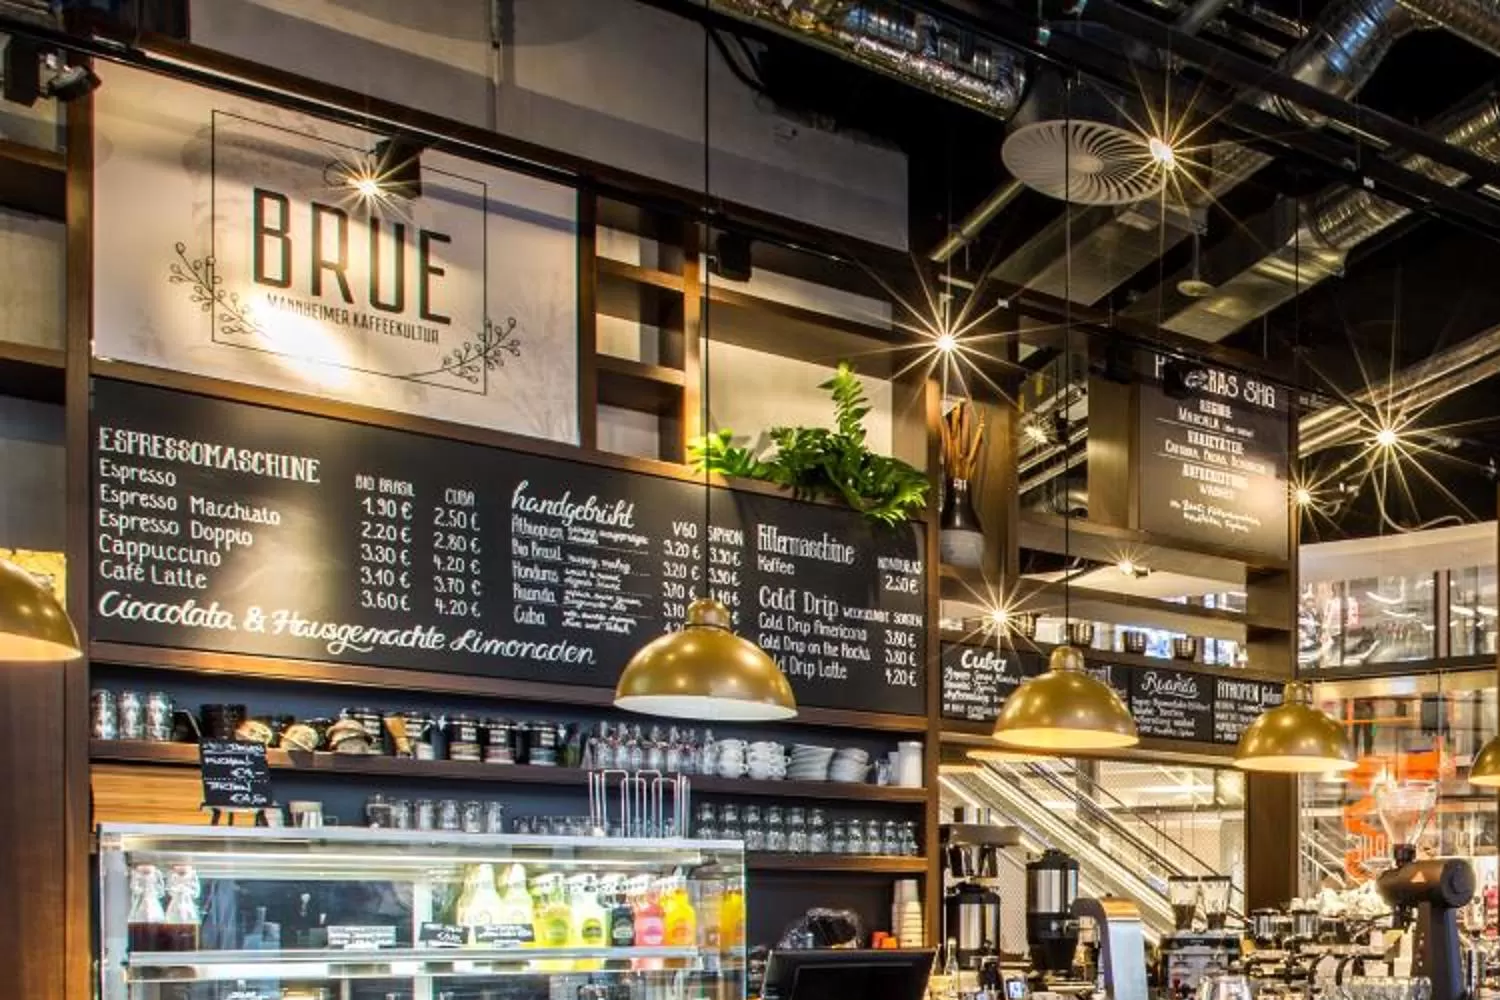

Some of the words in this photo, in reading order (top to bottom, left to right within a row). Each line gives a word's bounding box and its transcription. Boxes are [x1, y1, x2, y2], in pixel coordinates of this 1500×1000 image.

[253, 187, 452, 325] BRUE
[353, 311, 439, 343] KAFFEEKULTUR
[99, 427, 321, 483] ESPRESSOMASCHINE
[99, 458, 177, 487] Espresso
[379, 477, 416, 497] BRASIL
[445, 487, 475, 507] CUBA
[99, 484, 177, 510] Espresso
[190, 495, 281, 525] Macchiato
[361, 497, 397, 519] 1.90
[511, 479, 635, 529] handgebrüht
[99, 508, 180, 536] Espresso
[190, 520, 253, 551] Doppio
[433, 507, 467, 529] 2.50
[361, 521, 397, 541] 2.20
[672, 521, 697, 539] V60
[708, 525, 744, 546] SIPHON
[757, 523, 855, 564] Filtermaschine
[99, 534, 221, 567] Cappuccino
[360, 543, 396, 564] 3.30
[100, 559, 145, 582] Café
[151, 564, 207, 589] Latte
[433, 554, 465, 573] 4.20
[757, 554, 795, 575] Kaffee
[360, 566, 395, 587] 3.10
[361, 590, 398, 611] 3.60
[435, 598, 467, 616] 4.20
[759, 585, 796, 612] Cold
[803, 591, 839, 621] Drip
[513, 604, 547, 625] Cuba
[758, 612, 784, 630] Cold
[787, 615, 811, 636] Drip
[98, 590, 237, 631] Cioccolata
[243, 607, 266, 632] &
[270, 608, 446, 655] Hausgemachte
[449, 627, 597, 666] Limonaden
[758, 633, 781, 650] Cold
[783, 635, 805, 654] Drip
[807, 642, 821, 655] on
[823, 641, 839, 657] the
[841, 643, 871, 661] Rocks
[789, 655, 815, 680] Drip
[818, 659, 848, 679] Latte
[961, 649, 1007, 673] Cuba
